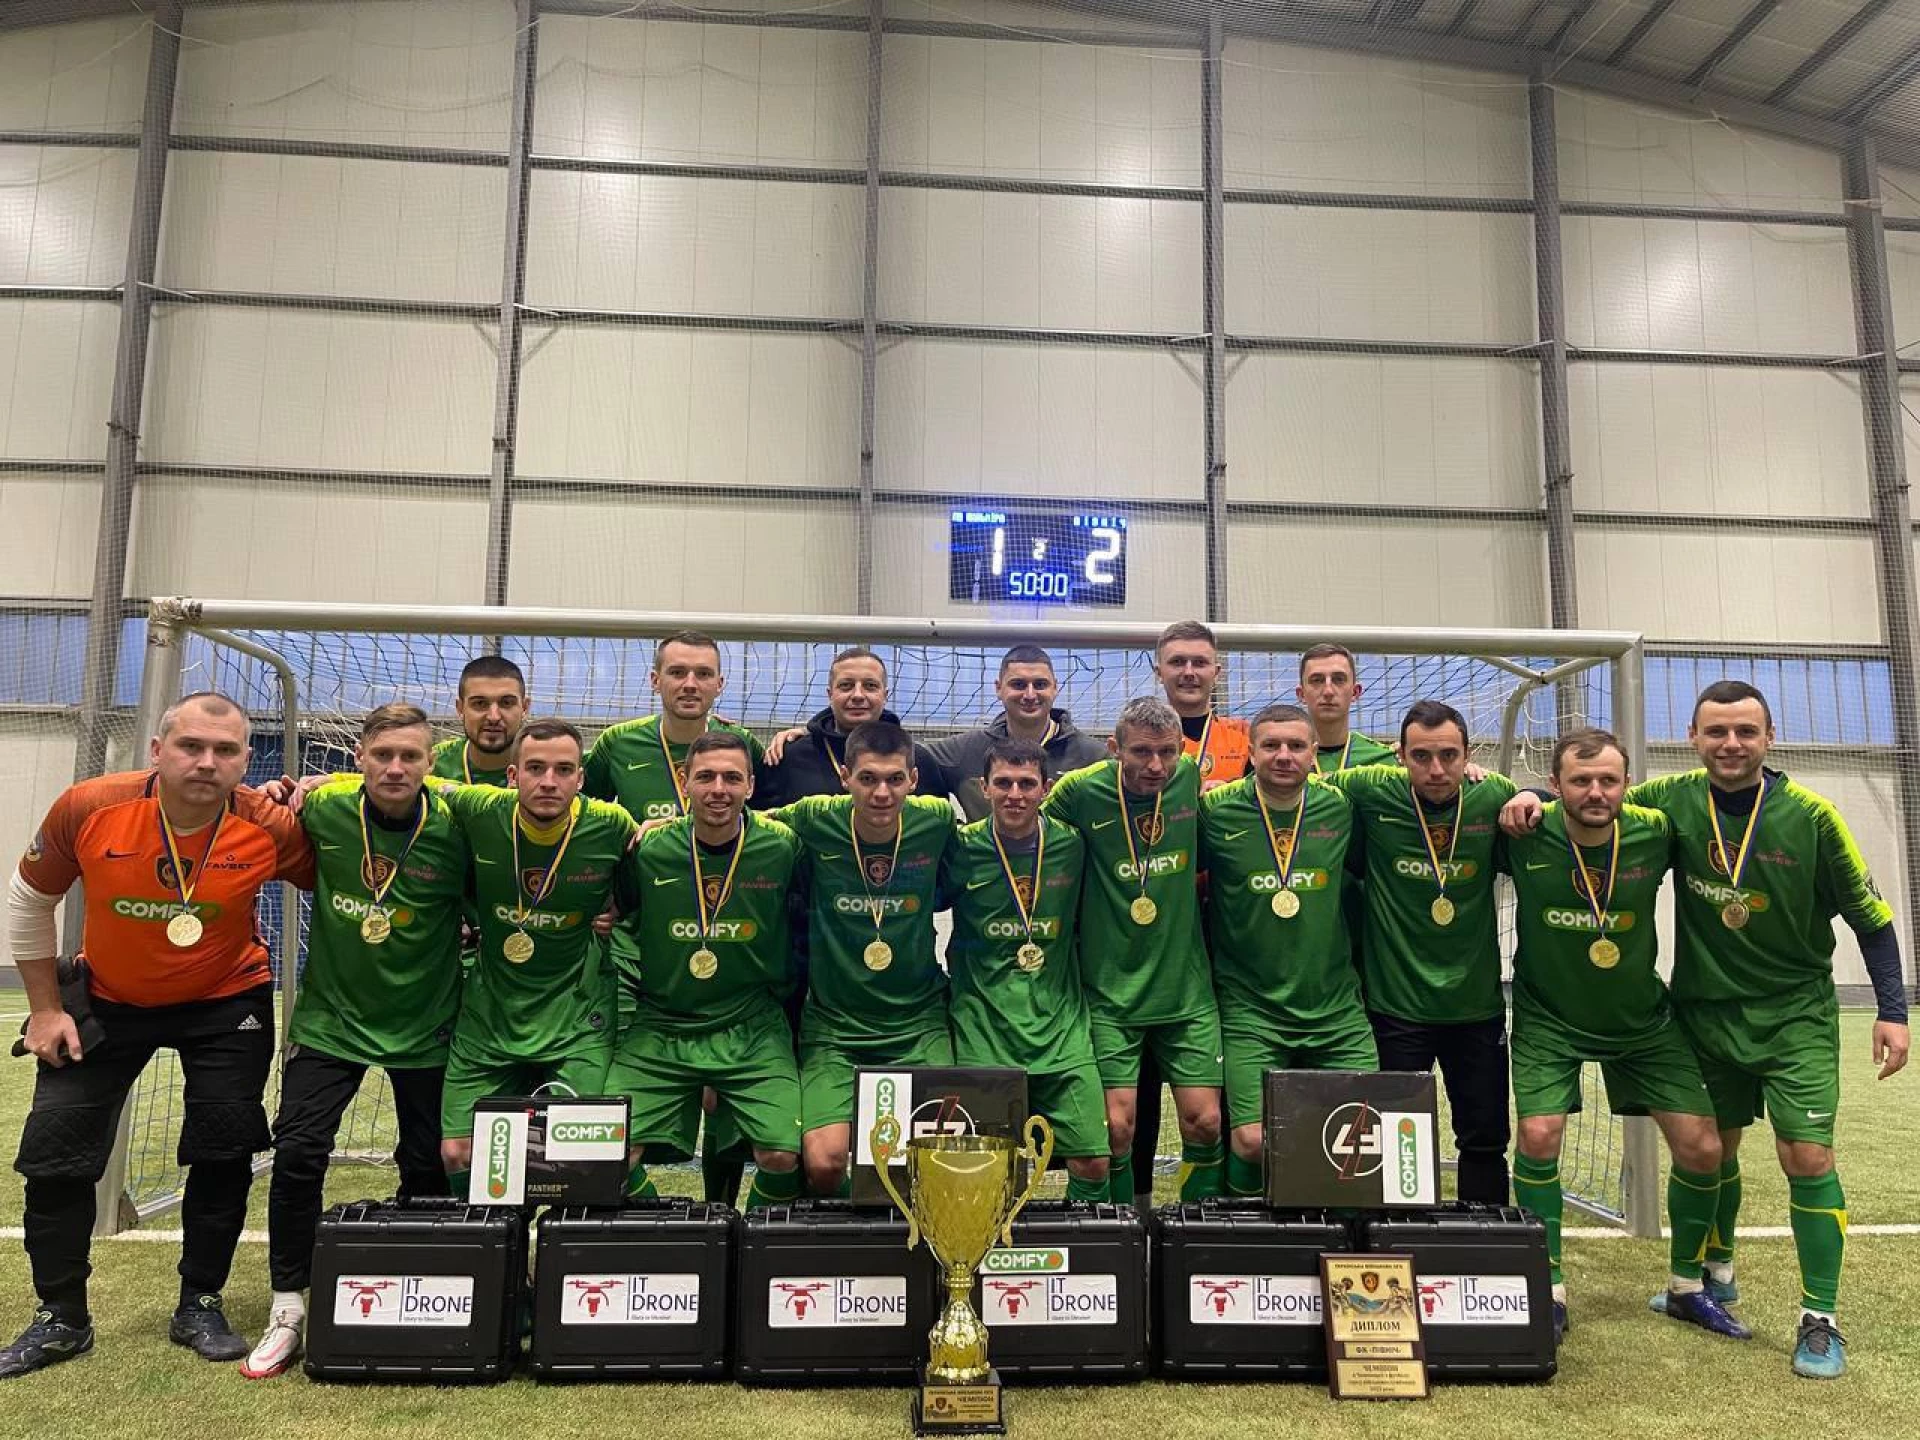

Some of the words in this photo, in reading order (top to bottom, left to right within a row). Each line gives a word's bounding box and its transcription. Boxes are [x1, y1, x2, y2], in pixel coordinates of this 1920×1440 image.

[992, 527, 1005, 576] 1
[1085, 527, 1121, 583] 2
[1010, 572, 1069, 597] 50:00
[554, 1126, 615, 1140] COMFY
[491, 1121, 508, 1183] COMFY
[1400, 1133, 1416, 1195] COMFY
[988, 1253, 1048, 1268] COMFY
[407, 1278, 423, 1294] IT
[633, 1276, 648, 1293] IT
[840, 1279, 855, 1295] IT
[1051, 1277, 1066, 1293] IT
[1257, 1277, 1272, 1293] IT
[1463, 1277, 1478, 1293] IT
[404, 1295, 471, 1313] DRONE
[632, 1294, 697, 1311] DRONE
[839, 1296, 905, 1313] DRONE
[1051, 1294, 1116, 1311] DRONE
[1257, 1295, 1321, 1311] DRONE
[1464, 1295, 1528, 1311] DRONE
[1350, 1321, 1401, 1333] ДИПЛОМ
